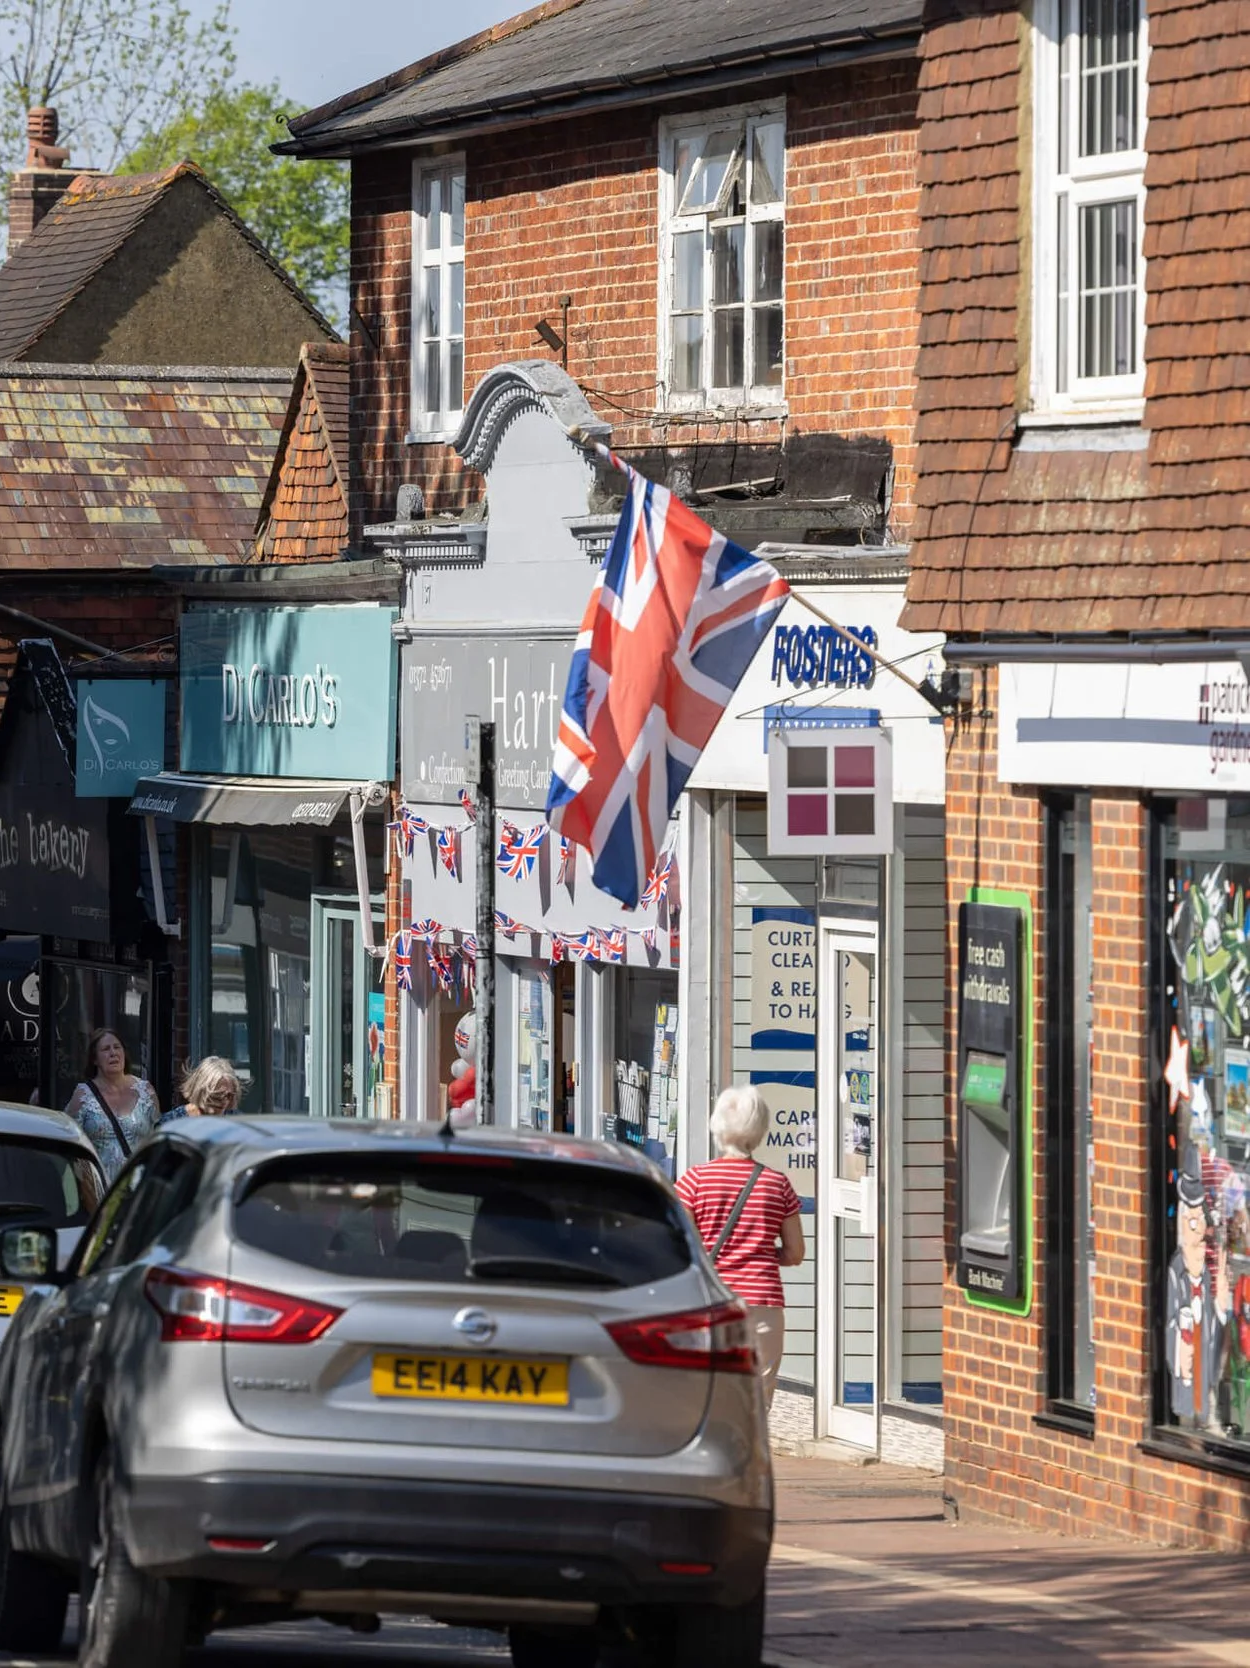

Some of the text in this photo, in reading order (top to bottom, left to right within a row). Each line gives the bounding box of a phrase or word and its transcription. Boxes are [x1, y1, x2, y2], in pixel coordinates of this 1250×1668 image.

[771, 624, 875, 686] FOSTERS
[497, 757, 530, 798] Greeting
[26, 812, 90, 880] bakery
[968, 937, 1006, 968] free cash
[771, 981, 784, 997] &
[769, 1003, 792, 1019] TO
[788, 1153, 816, 1169] HIR
[393, 1358, 548, 1397] EE14 KAY
